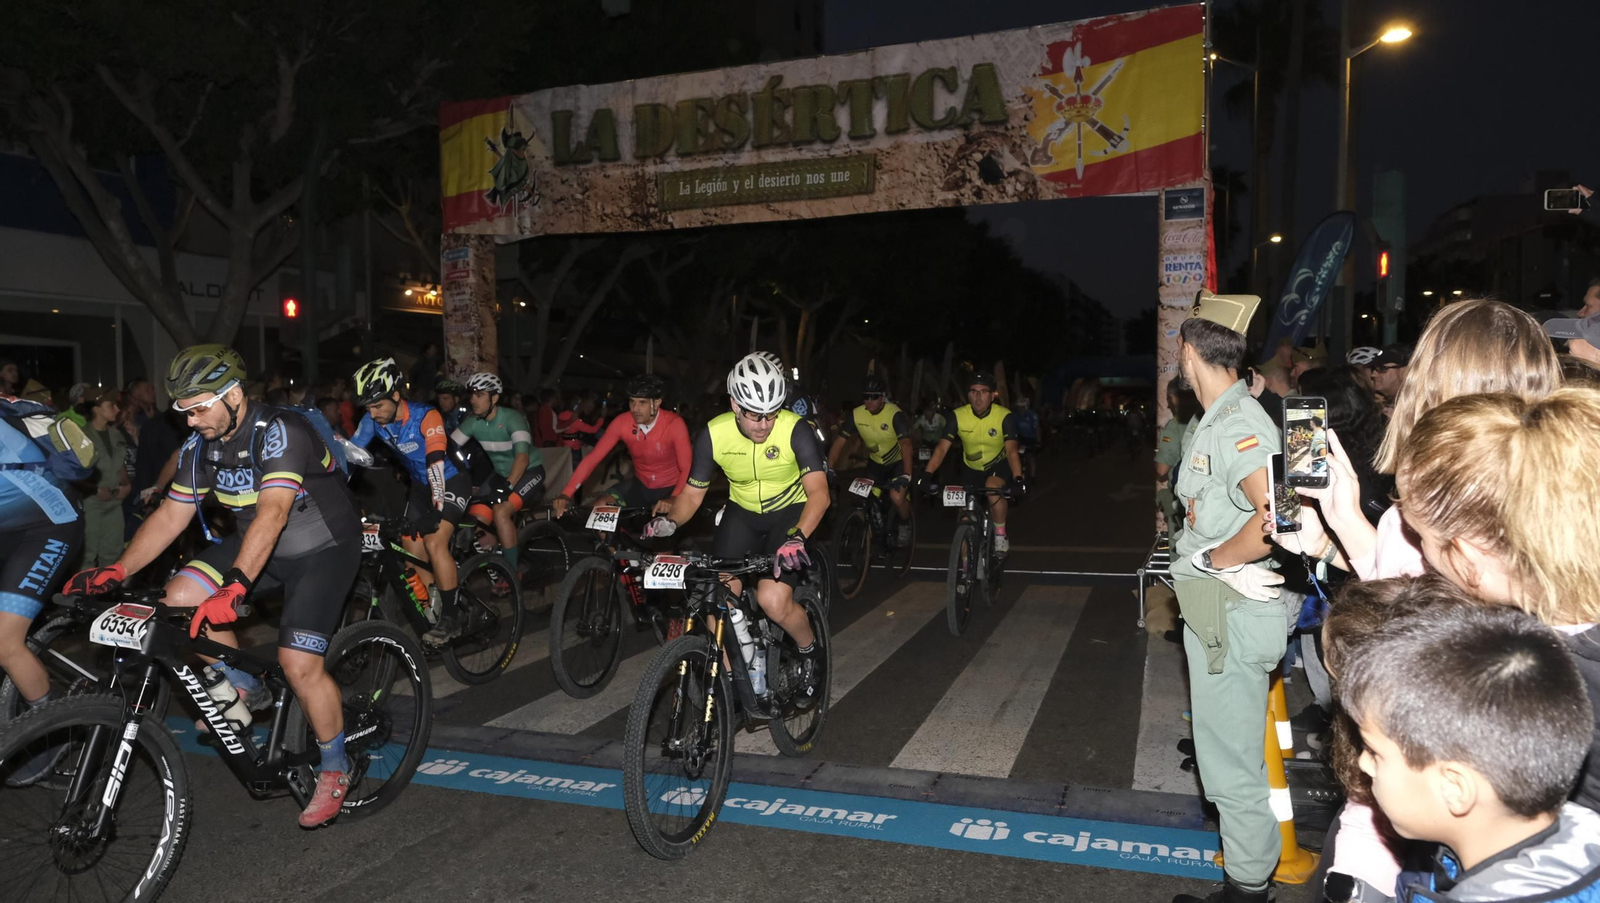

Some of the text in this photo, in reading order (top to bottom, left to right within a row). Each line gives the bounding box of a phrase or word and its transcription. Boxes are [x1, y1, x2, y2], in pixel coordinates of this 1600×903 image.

[551, 62, 1006, 168] LA DESÉRTICA
[679, 169, 850, 197] La Legión y el desierto nos une
[1165, 261, 1202, 272] RENTA
[39, 489, 68, 517] BIKES
[946, 490, 965, 501] 6753
[594, 512, 616, 523] 7684
[18, 538, 64, 590] TITAN
[47, 555, 64, 579] MANCHA
[651, 562, 684, 578] 6298
[100, 614, 140, 638] 6554
[172, 664, 247, 755] SPECIALIZED
[467, 767, 617, 793] cajamar
[526, 784, 598, 798] CAJA RURAL
[723, 797, 899, 824] cajamar
[173, 820, 185, 845] TRAK
[800, 816, 884, 831] CAJA RURAL
[1119, 852, 1223, 870] CAJA RURAL
